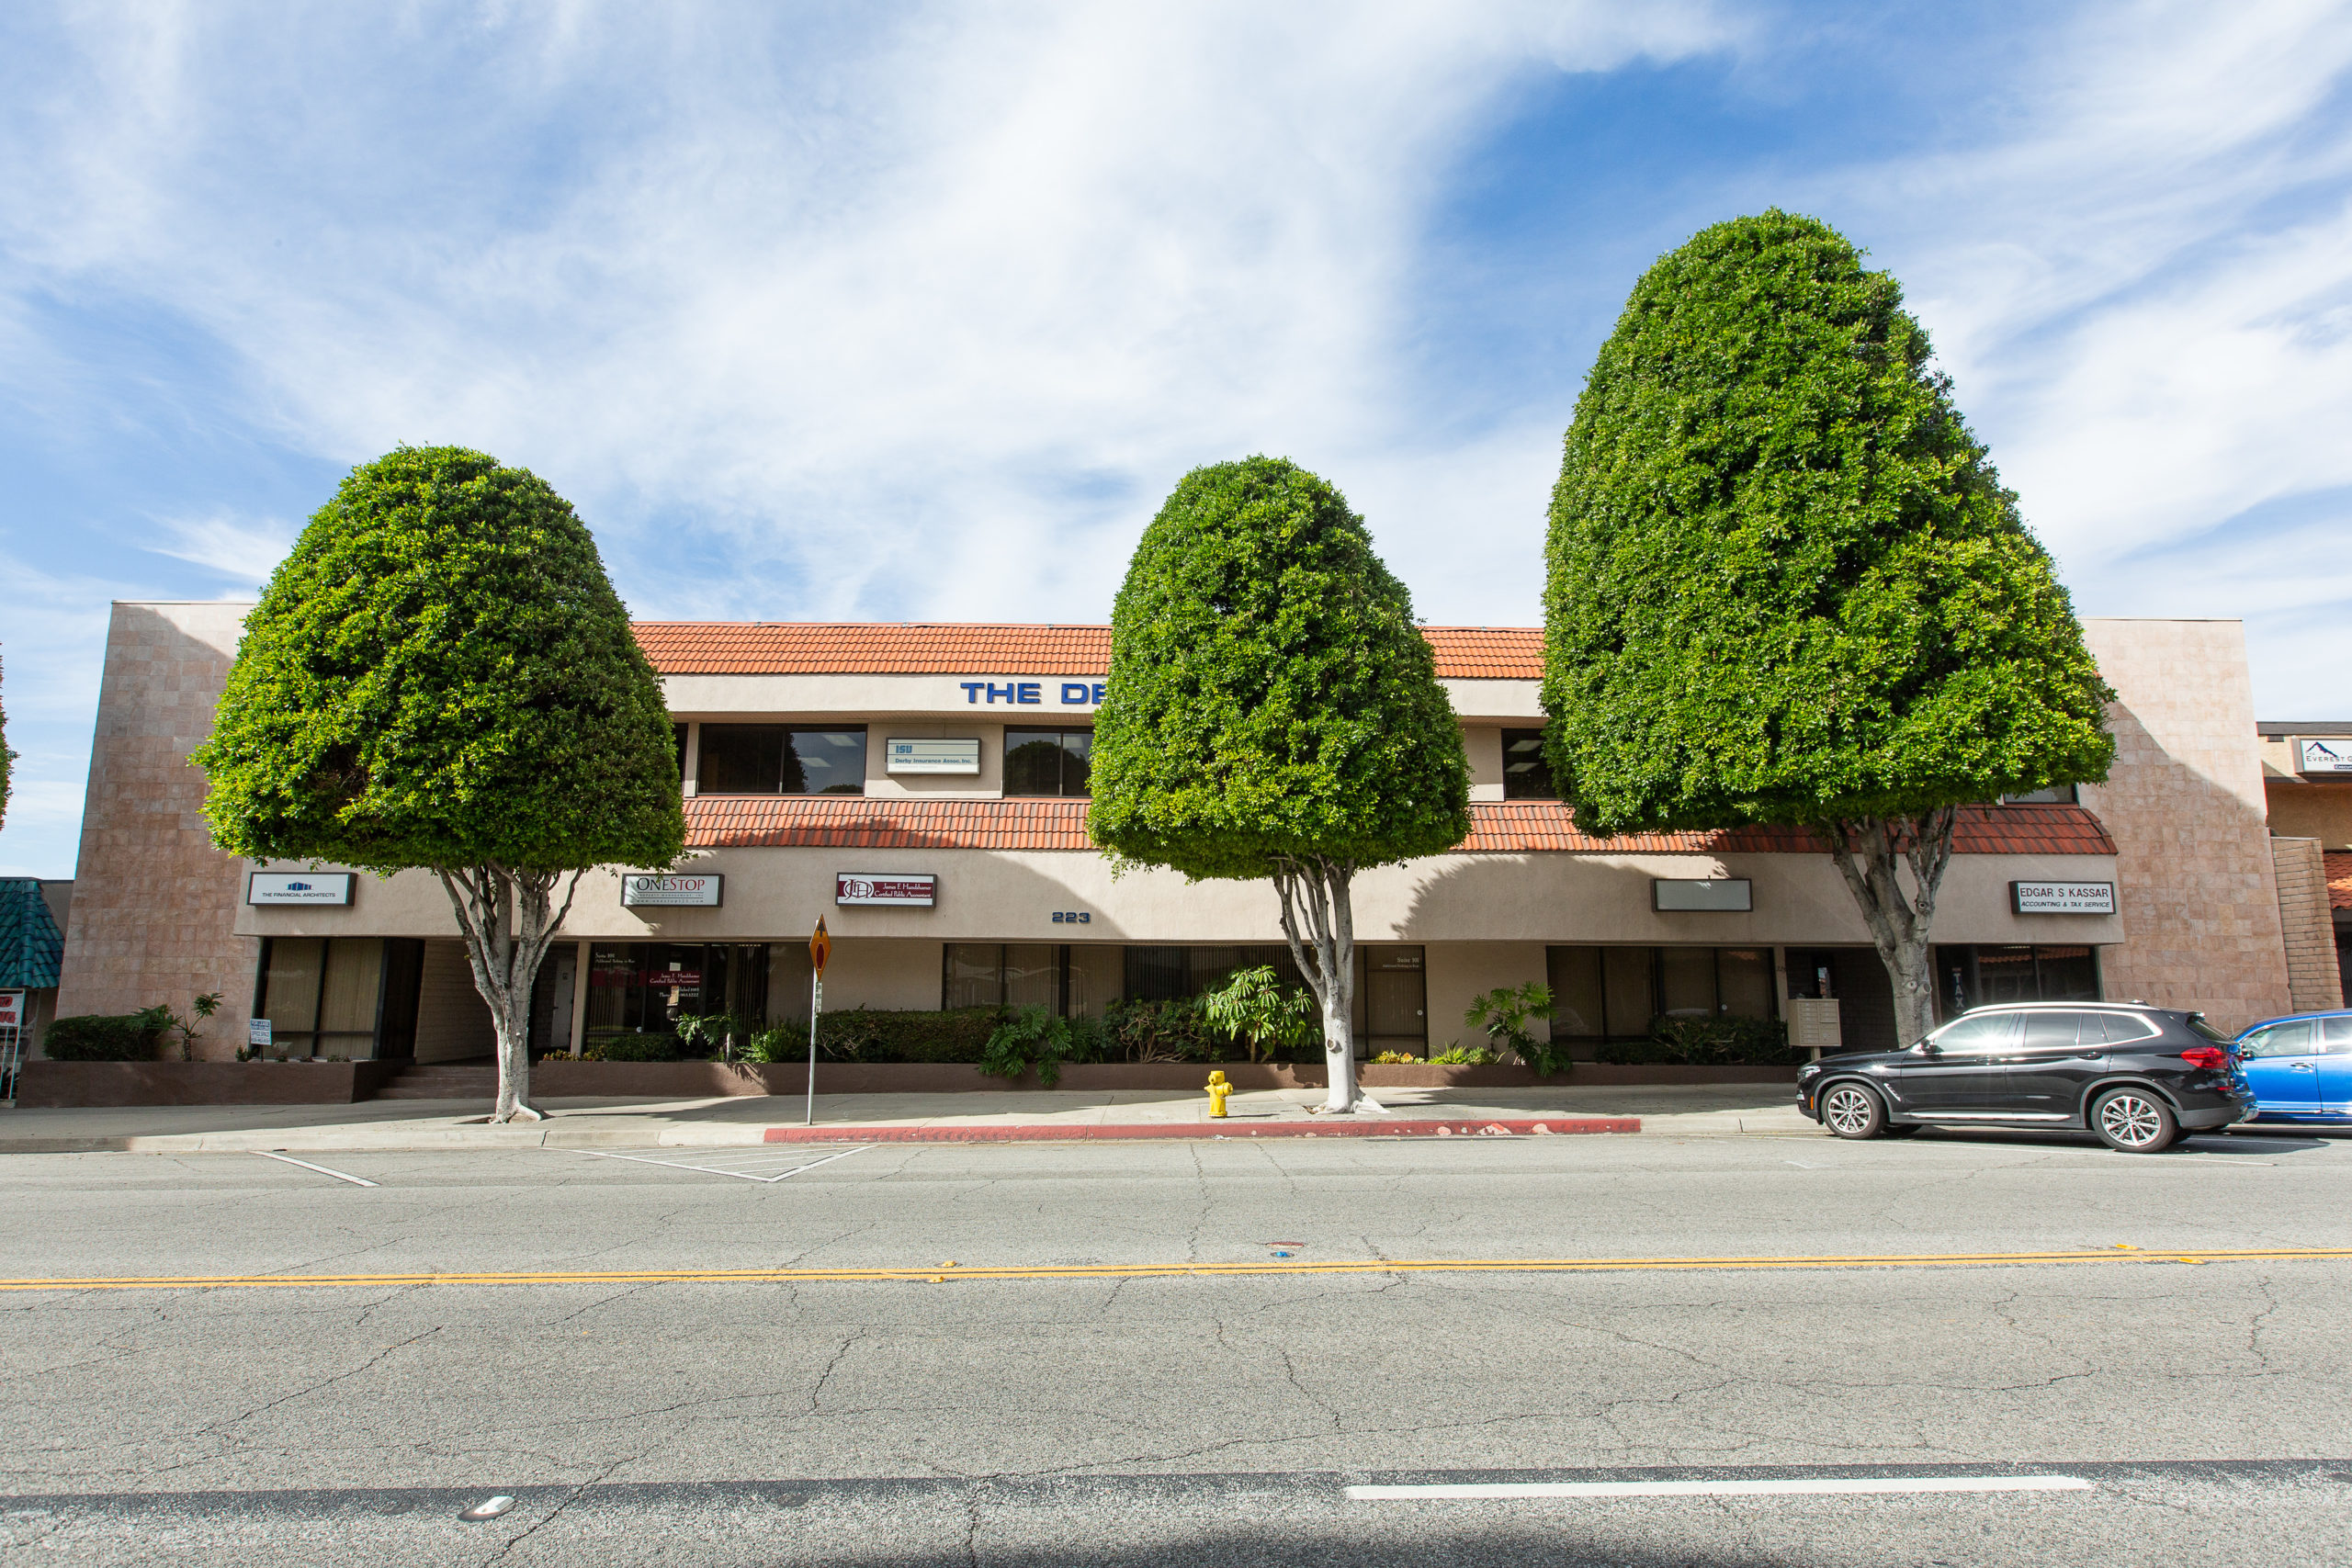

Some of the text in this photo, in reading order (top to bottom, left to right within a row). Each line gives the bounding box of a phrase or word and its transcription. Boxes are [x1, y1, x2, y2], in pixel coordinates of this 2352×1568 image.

[960, 682, 1040, 704] THE
[895, 745, 912, 754] ISU
[2020, 887, 2109, 897] EDGAR S KASSAR
[1052, 912, 1091, 923] 223
[1952, 973, 1964, 1008] TAX
